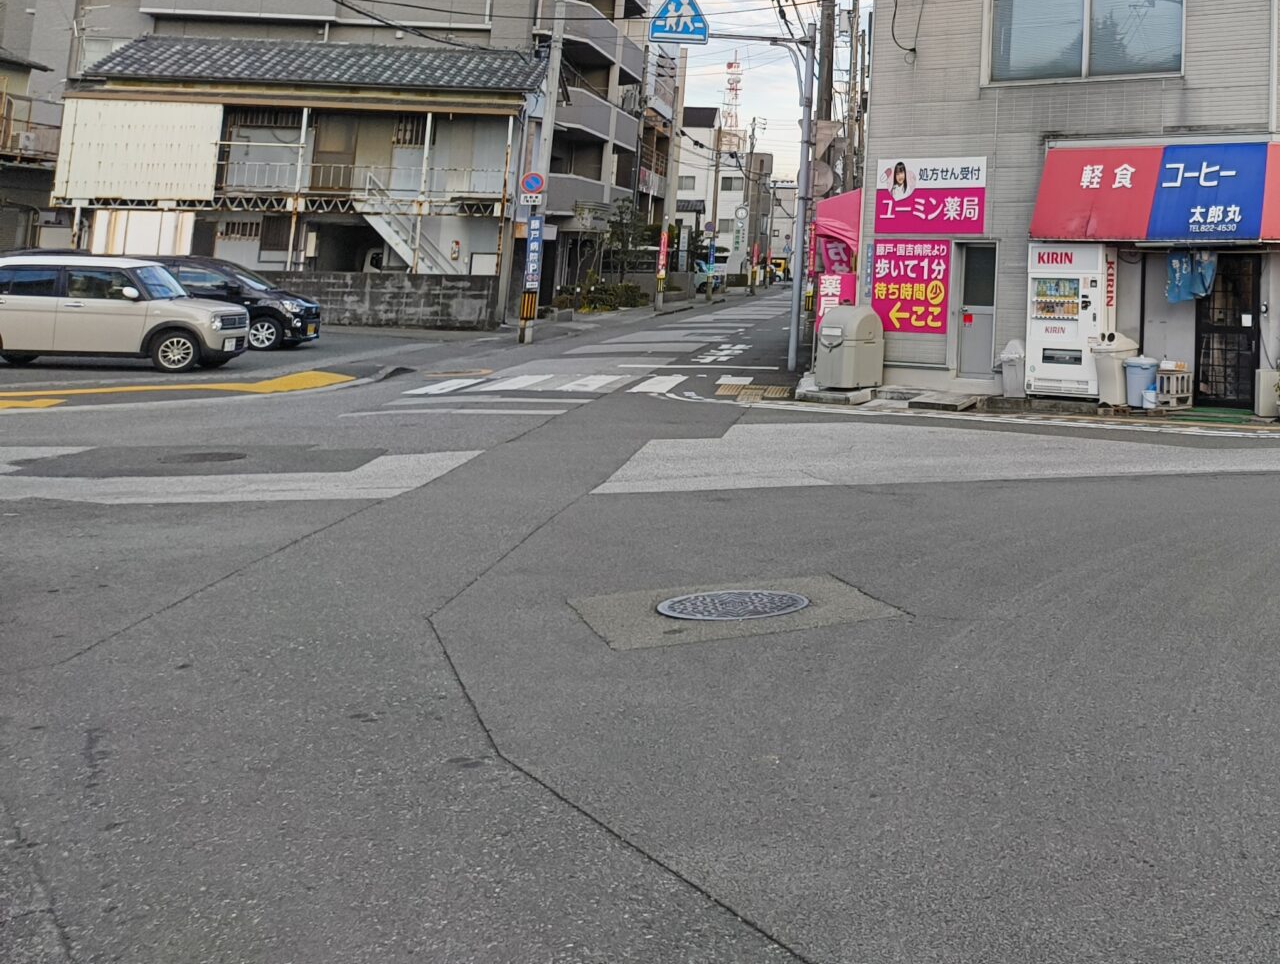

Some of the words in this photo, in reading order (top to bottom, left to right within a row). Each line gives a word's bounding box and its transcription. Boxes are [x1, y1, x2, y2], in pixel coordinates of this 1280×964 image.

[918, 166, 981, 182] 処方せん受付
[1080, 163, 1136, 189] 軽食
[1162, 162, 1237, 188] コーヒー
[879, 196, 979, 221] ユーミン薬局
[1189, 204, 1242, 224] 太郎丸
[875, 258, 946, 280] 歩いて1分
[1037, 251, 1073, 265] KIRIN
[1106, 260, 1115, 307] KIRIN
[911, 306, 942, 328] ここ
[1044, 325, 1066, 334] KIRIN
